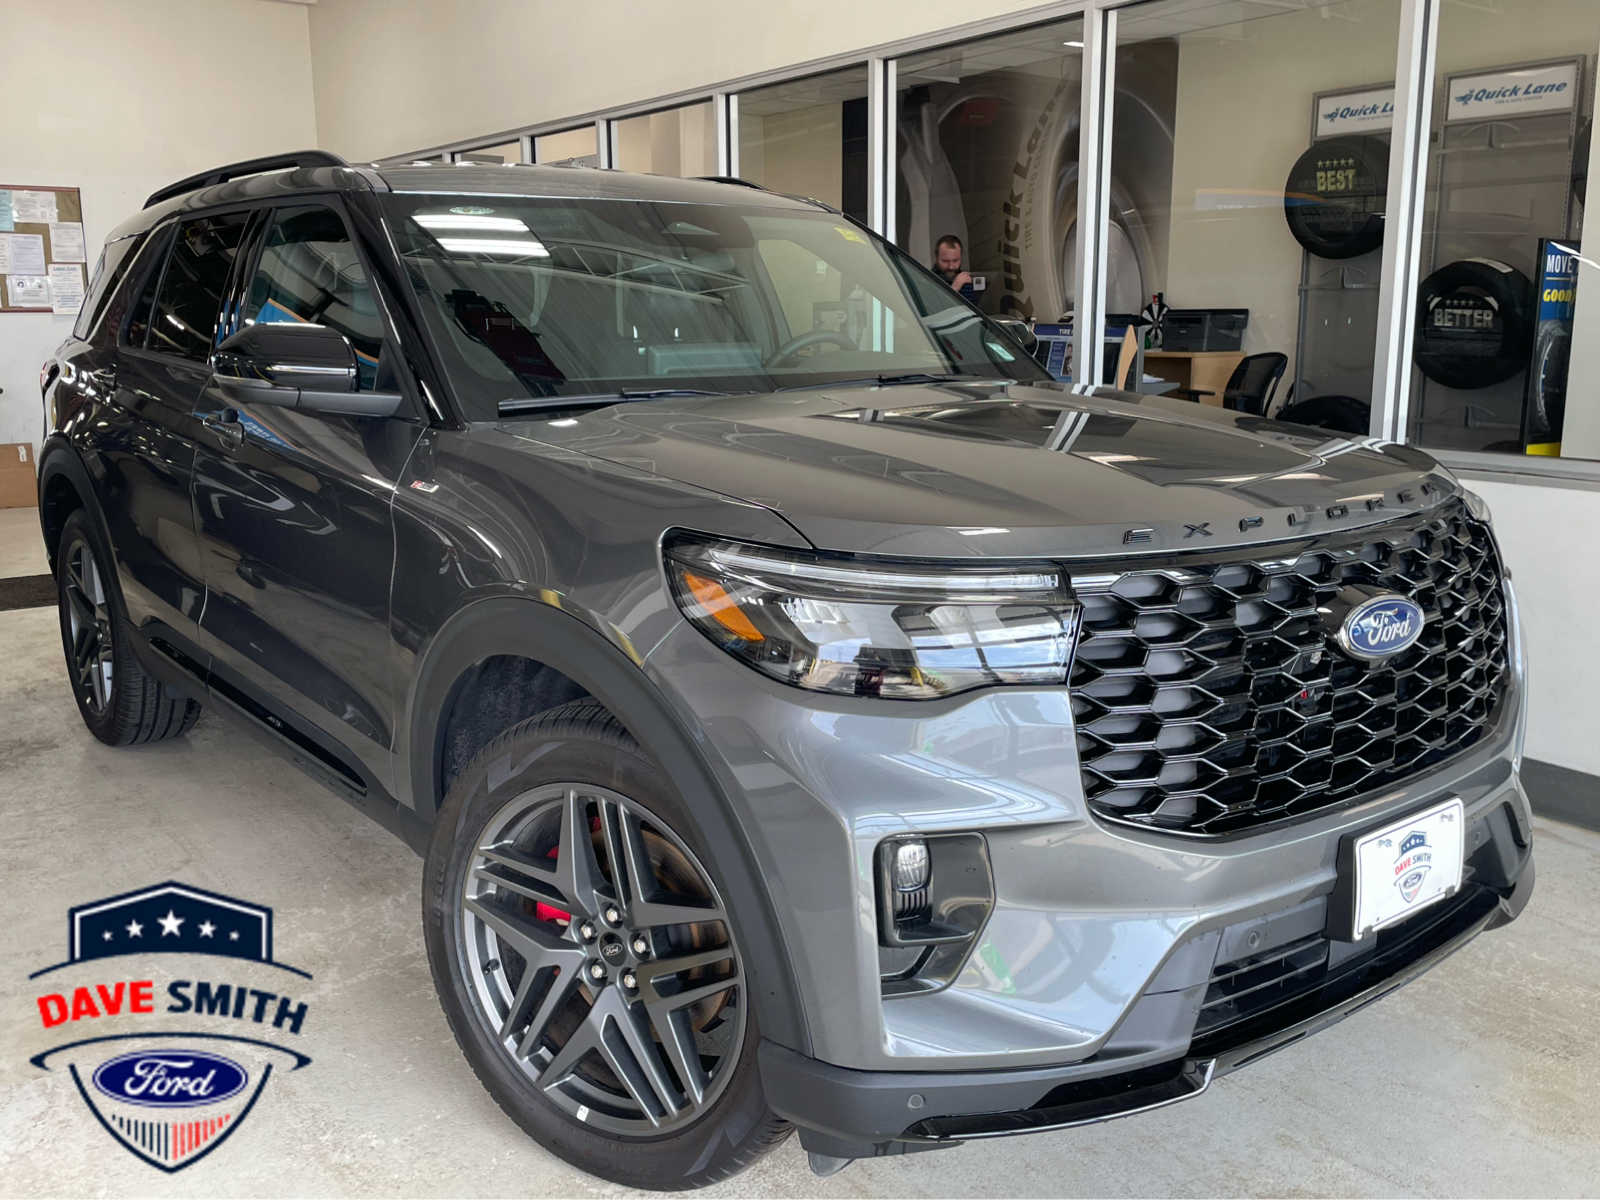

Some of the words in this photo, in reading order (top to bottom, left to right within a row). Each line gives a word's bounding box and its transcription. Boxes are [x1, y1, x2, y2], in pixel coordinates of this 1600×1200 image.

[1473, 84, 1522, 102] Quick
[1523, 81, 1567, 96] Lane
[1340, 103, 1380, 119] Quick
[1316, 169, 1356, 192] BEST
[1546, 255, 1573, 273] MOVE
[1434, 308, 1494, 327] BETTER
[1122, 481, 1439, 544] EXPLORER
[1369, 609, 1413, 645] Ford
[1395, 857, 1411, 875] DAVE
[1412, 853, 1432, 864] SMITH
